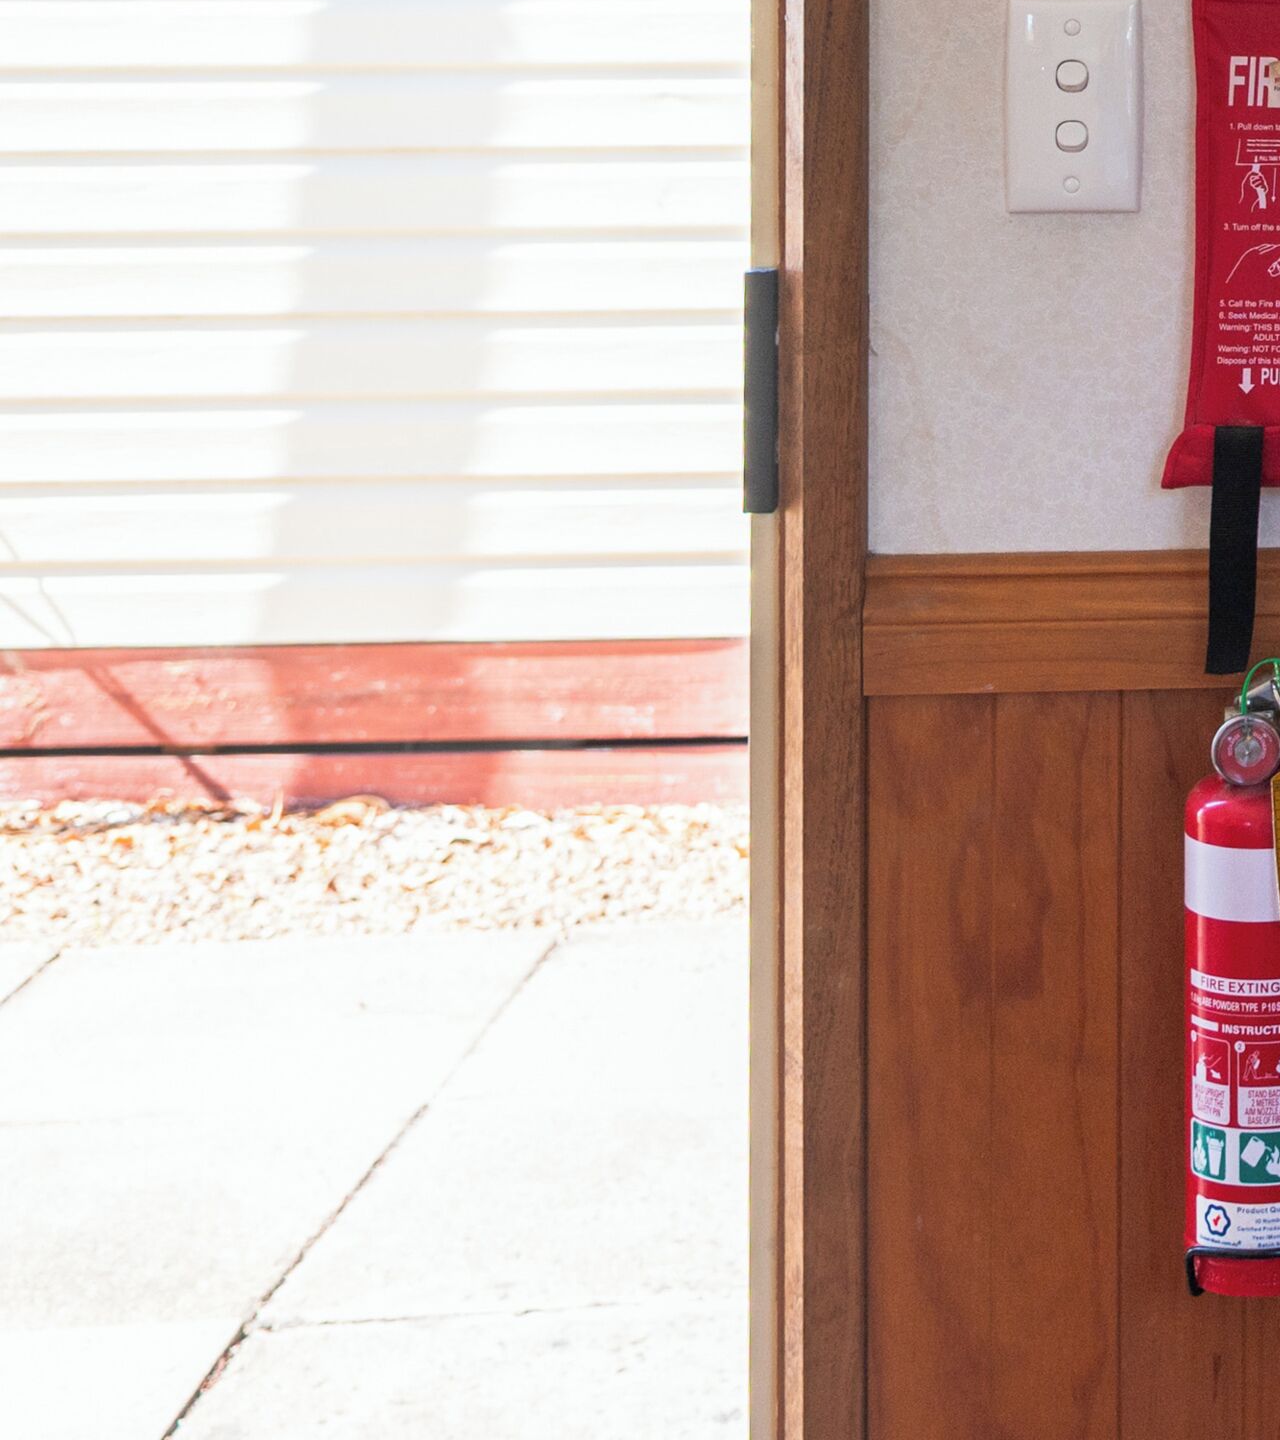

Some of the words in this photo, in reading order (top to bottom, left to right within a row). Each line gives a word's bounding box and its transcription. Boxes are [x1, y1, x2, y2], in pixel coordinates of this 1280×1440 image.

[1237, 123, 1252, 131] Pull
[1232, 223, 1249, 231] Turn
[1250, 223, 1261, 231] off
[1249, 312, 1278, 320] Medical
[1219, 323, 1252, 332] Warning:
[1253, 323, 1272, 331] THIS
[1218, 345, 1251, 354] Warning:
[1217, 357, 1247, 365] Dispose
[1258, 357, 1271, 365] this
[1201, 976, 1225, 992] FIRE
[1212, 999, 1240, 1012] POWDER
[1240, 1002, 1258, 1013] TYPE
[1248, 1089, 1267, 1098] STAND
[1236, 1206, 1268, 1214] Product
